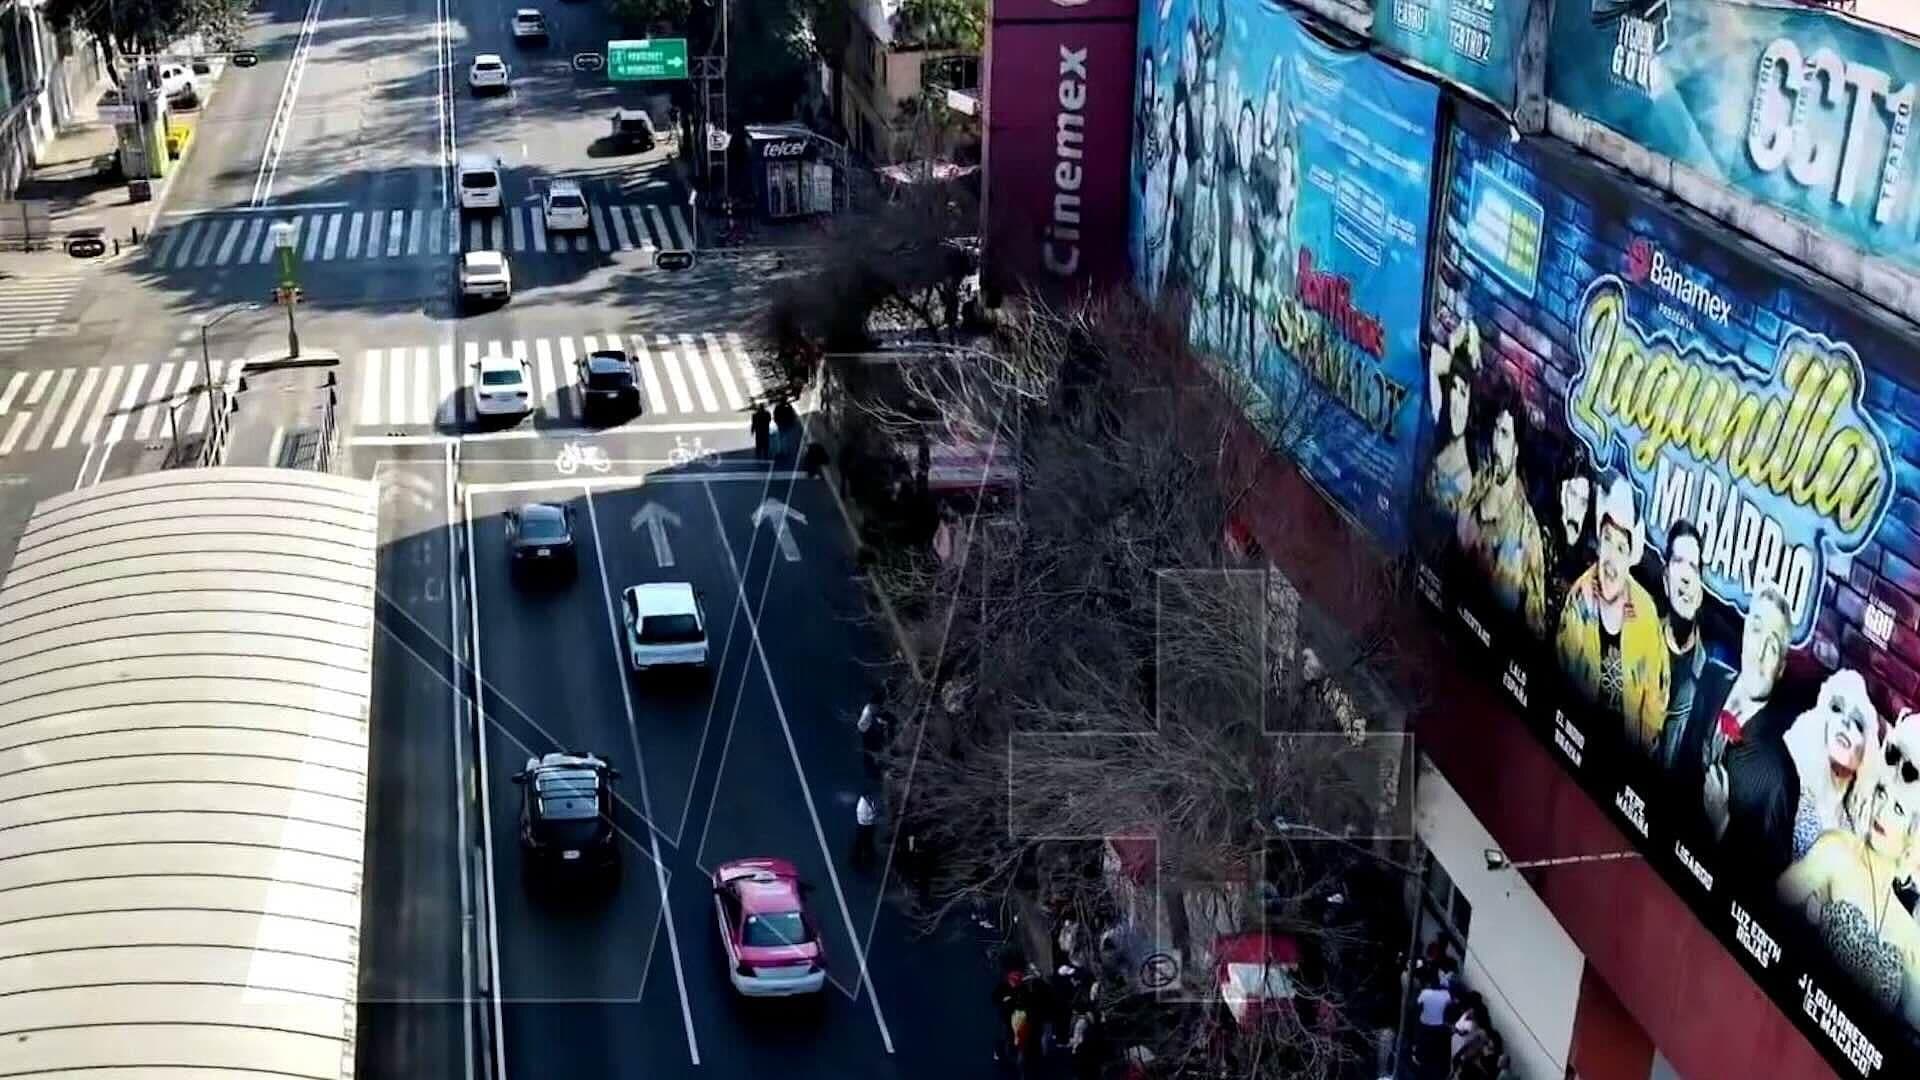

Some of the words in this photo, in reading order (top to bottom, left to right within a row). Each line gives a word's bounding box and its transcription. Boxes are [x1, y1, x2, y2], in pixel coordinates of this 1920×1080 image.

[763, 139, 806, 157] telcel
[1044, 44, 1088, 276] Cinemex
[1880, 100, 1911, 200] TEATRO
[1650, 250, 1732, 328] Banamex
[1573, 294, 1882, 532] Lagunilla
[1650, 455, 1694, 533] MI
[1696, 467, 1815, 626] BARRIO
[1730, 899, 1751, 931] LUZ
[1736, 923, 1770, 969] ROJAS
